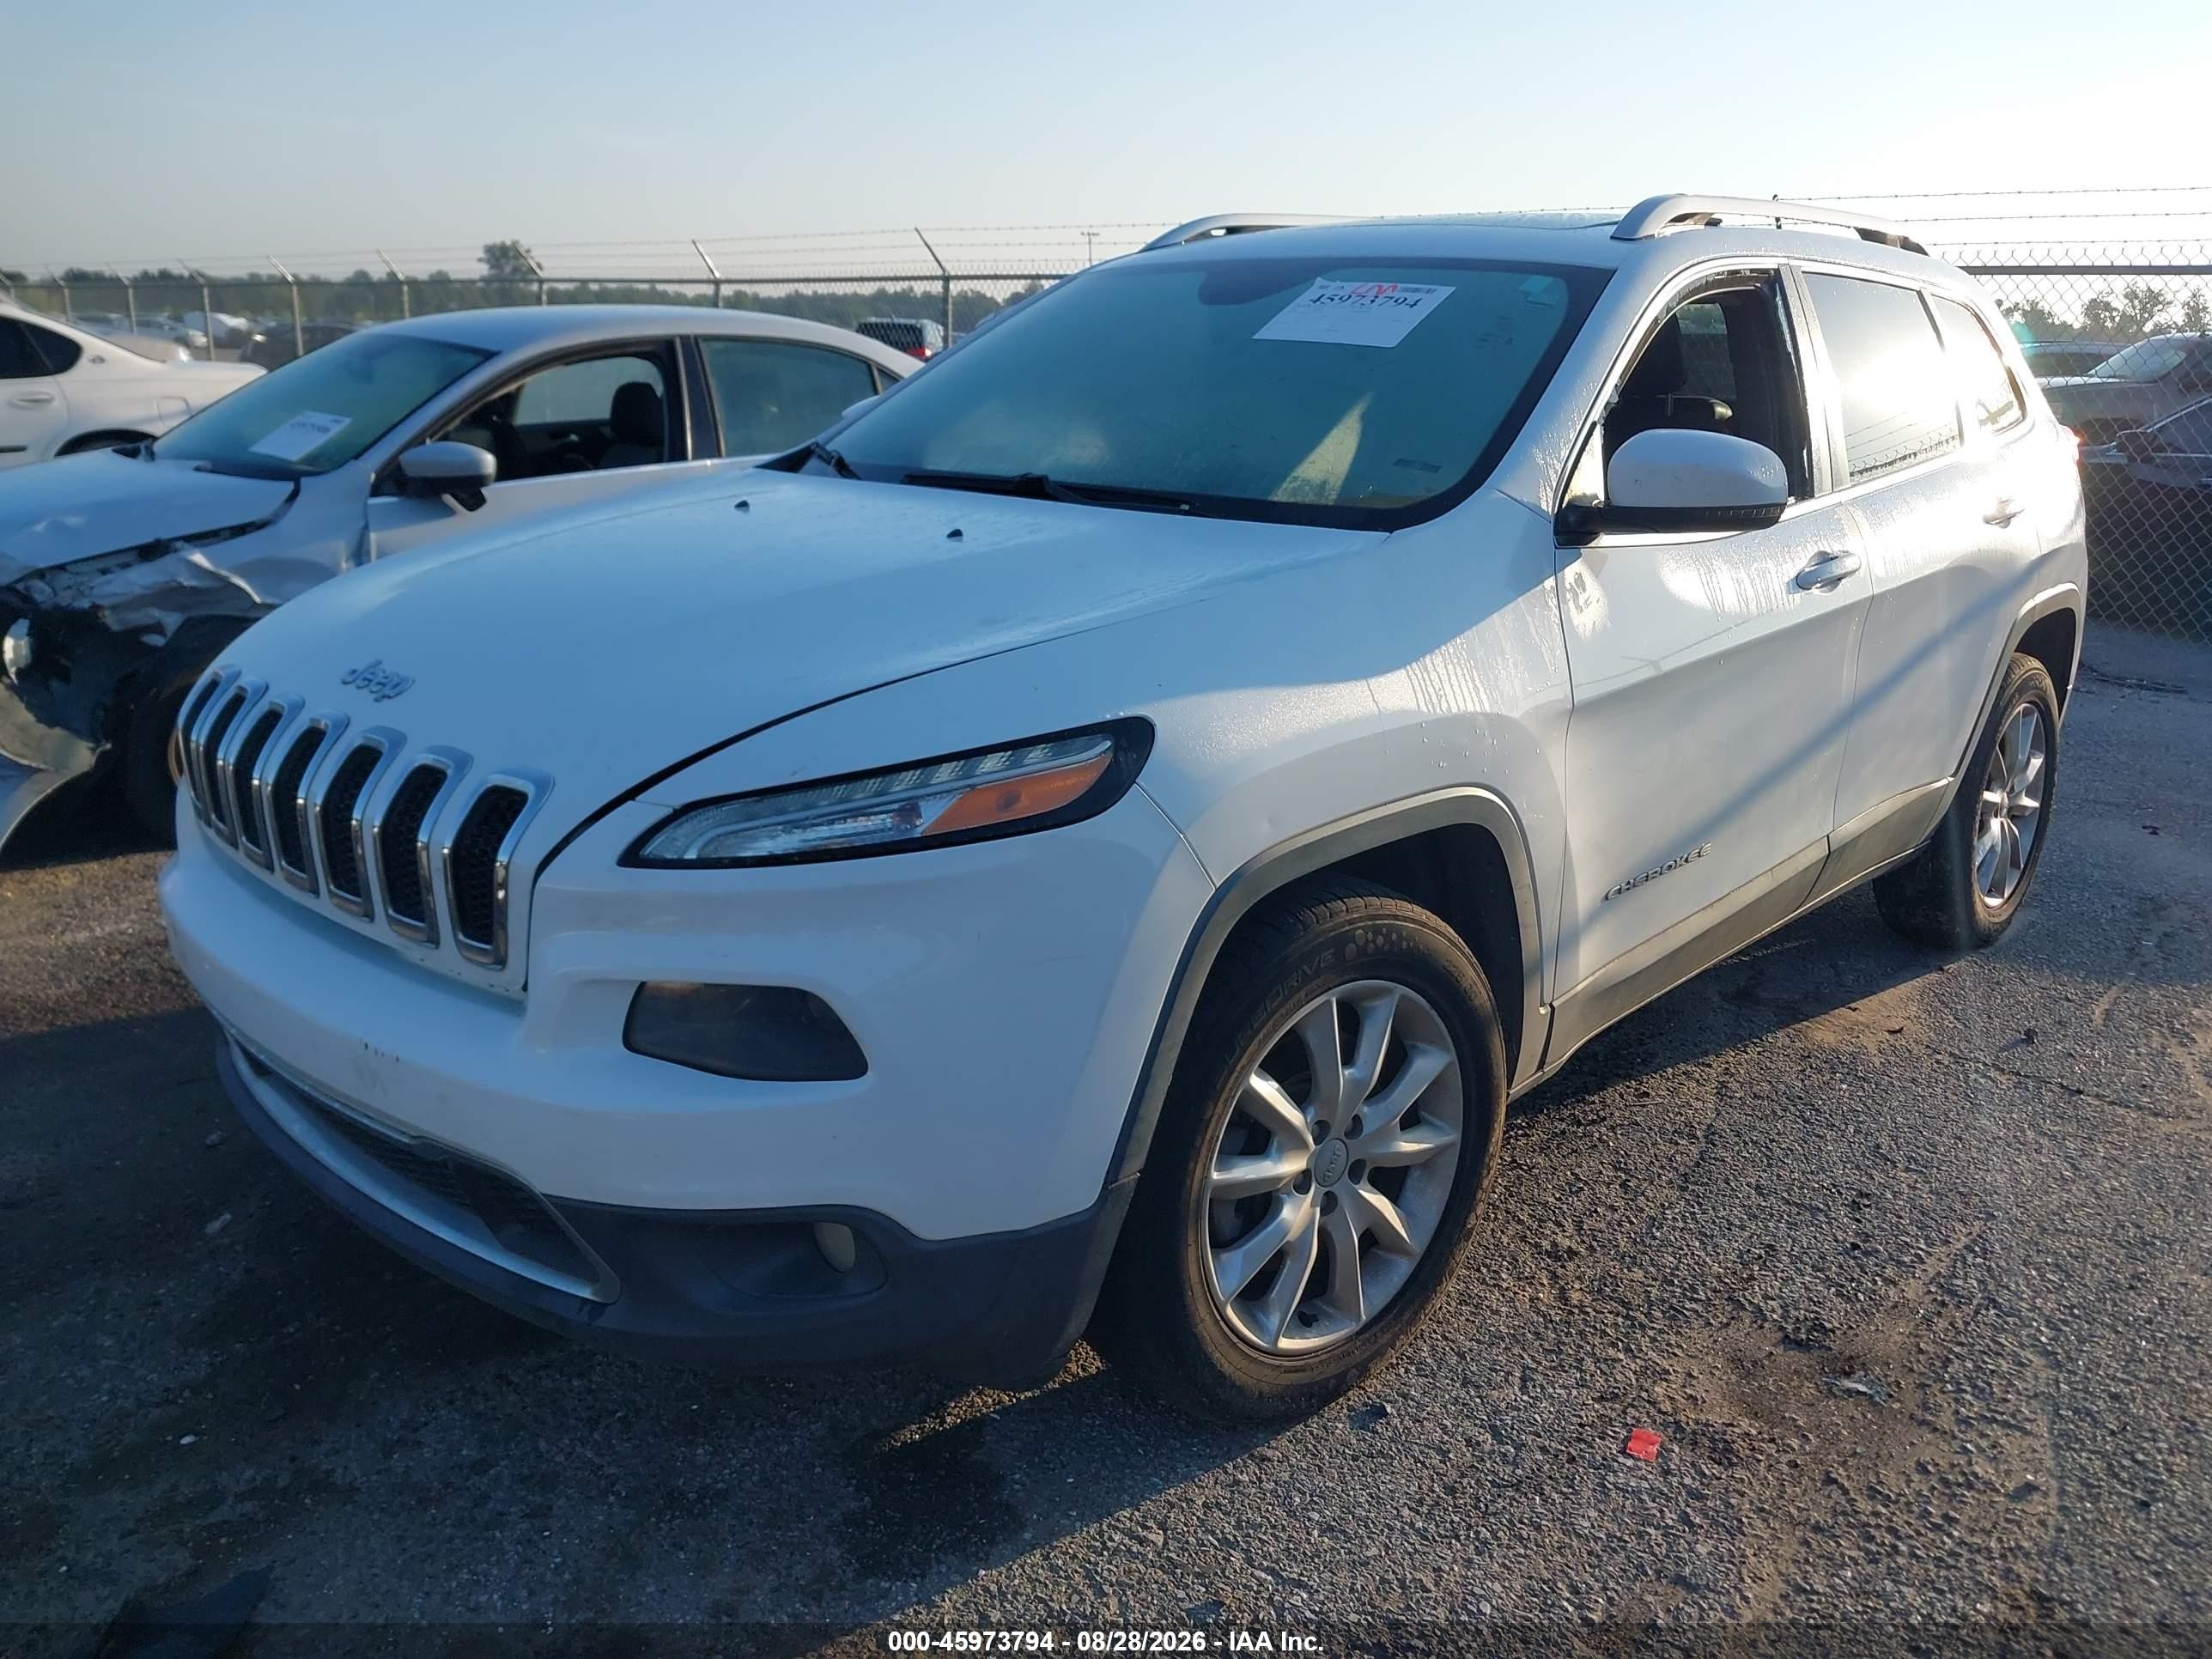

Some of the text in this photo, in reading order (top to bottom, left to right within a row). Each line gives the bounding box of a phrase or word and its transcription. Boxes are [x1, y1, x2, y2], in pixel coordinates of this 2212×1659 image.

[1310, 293, 1423, 309] 45973794
[341, 659, 416, 702] Jeep
[1605, 842, 1712, 901] CHEROKEE
